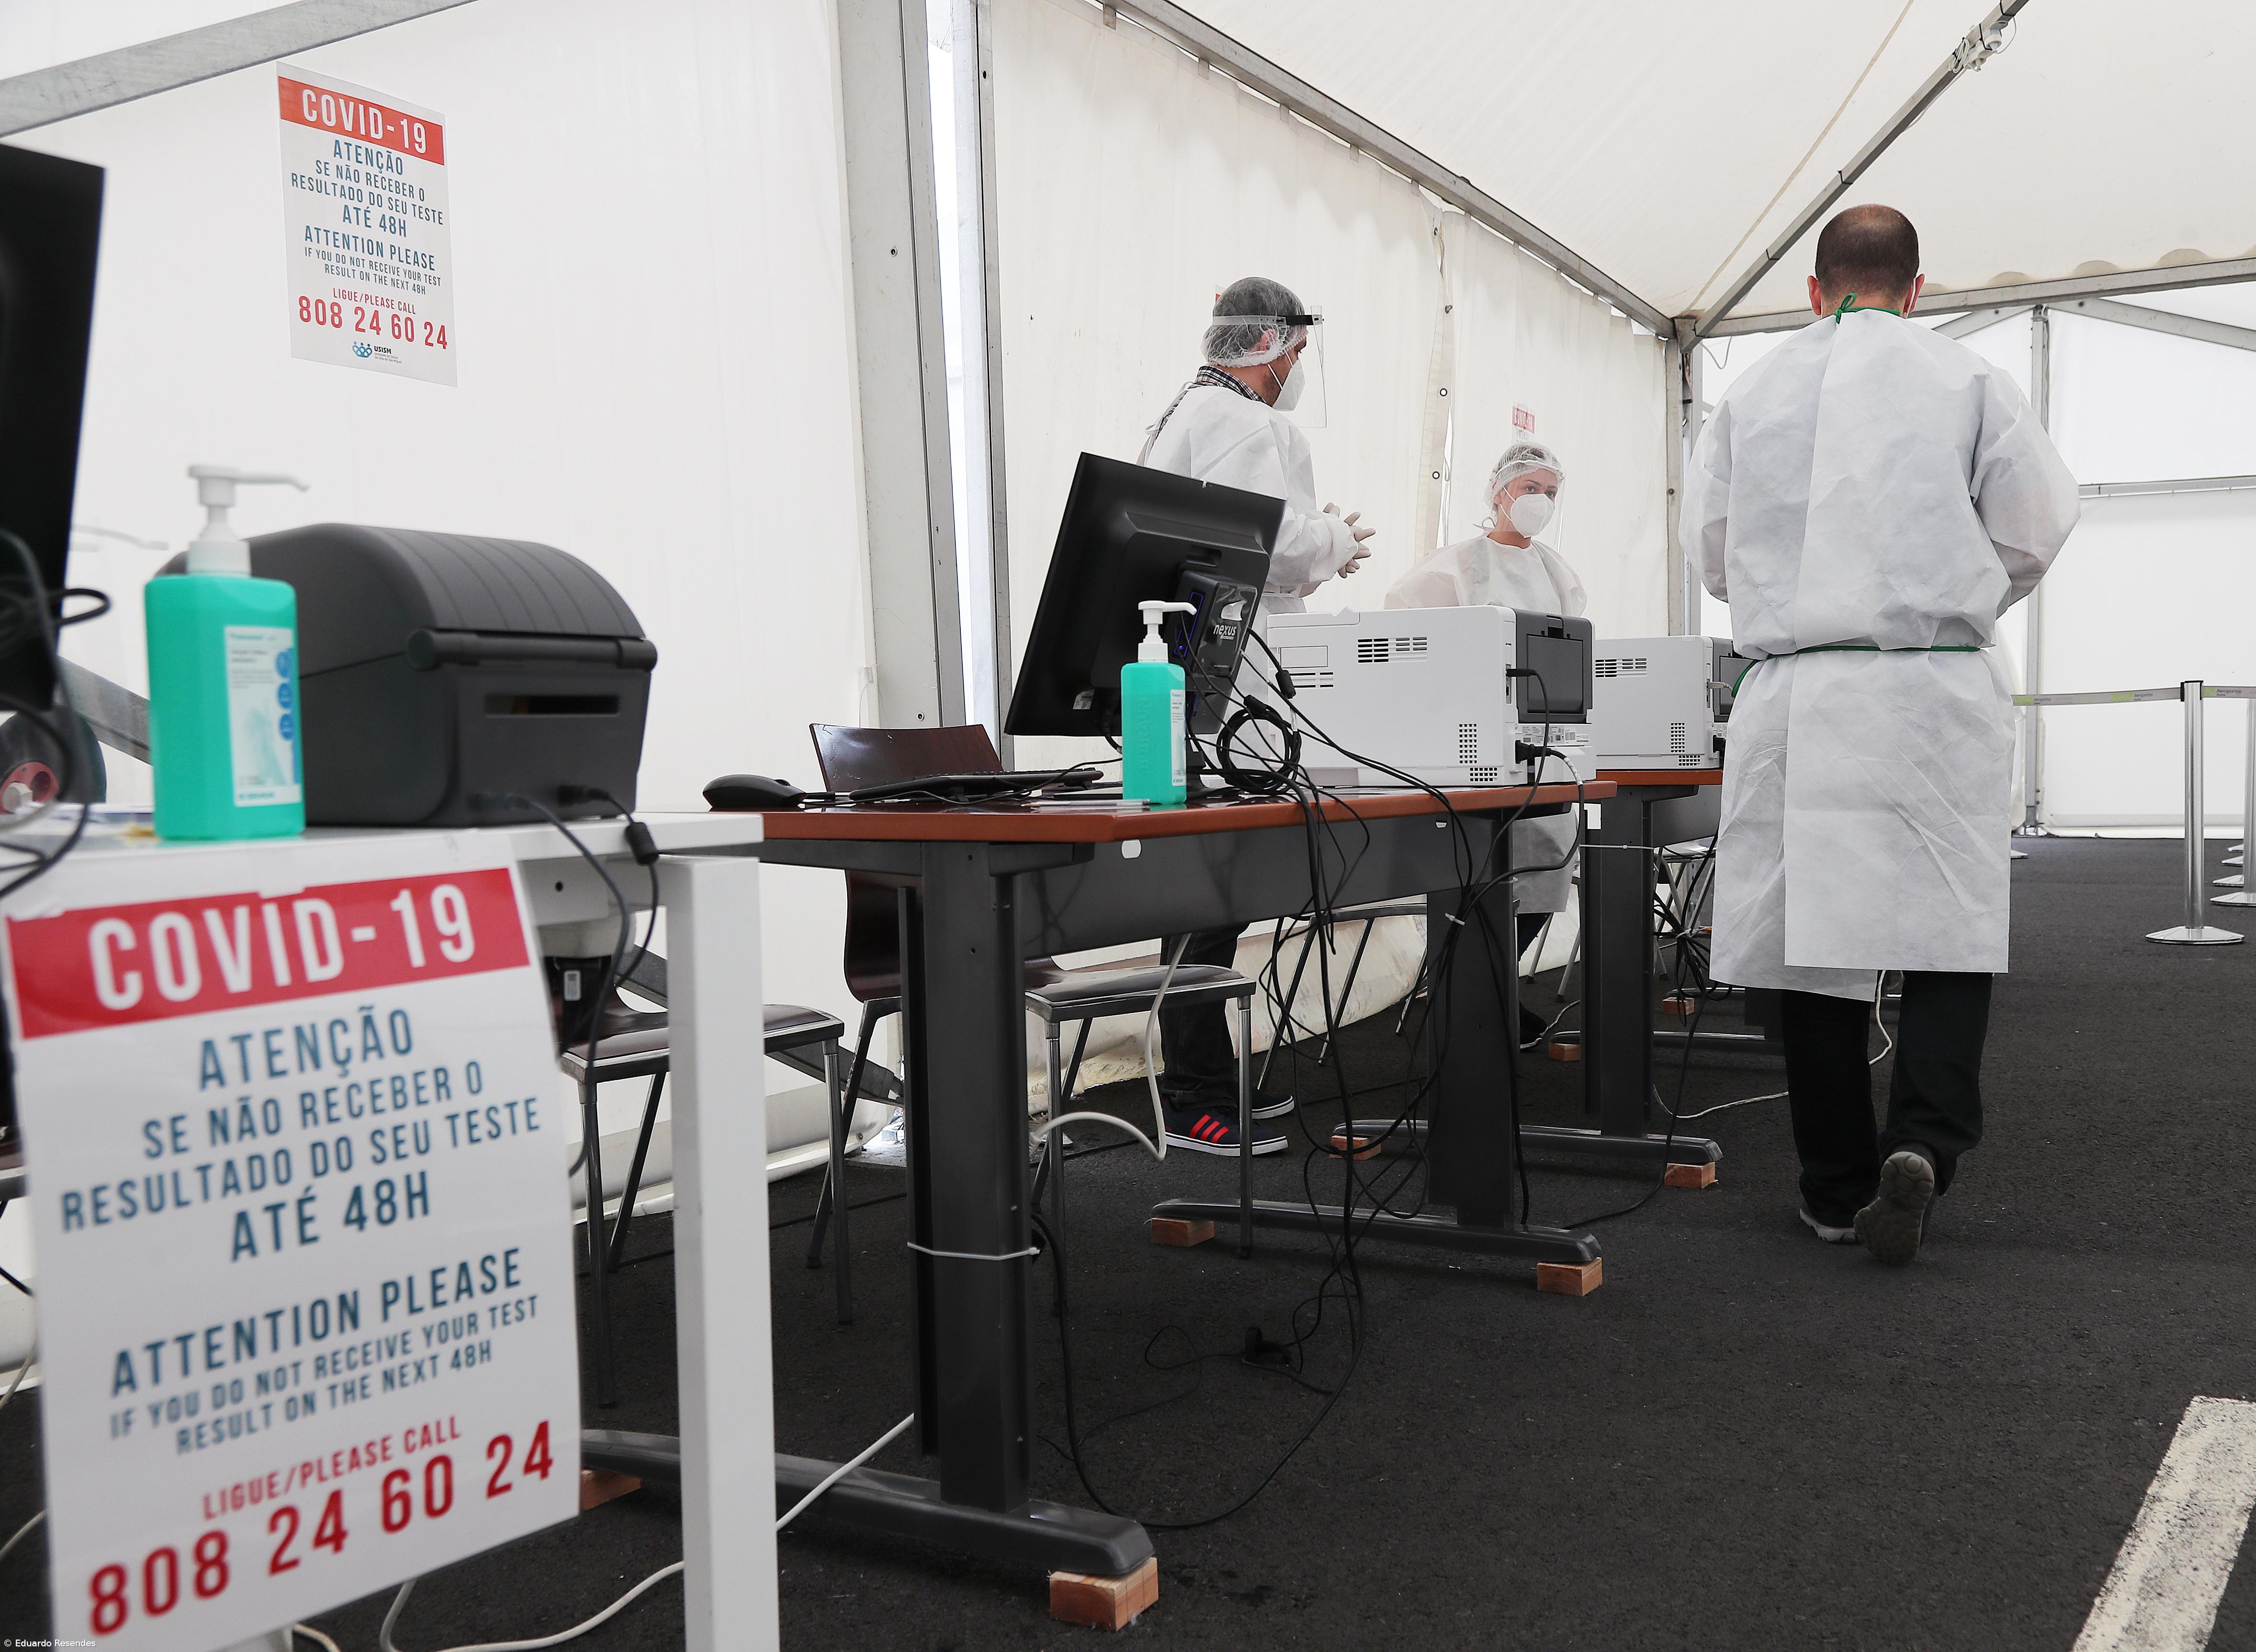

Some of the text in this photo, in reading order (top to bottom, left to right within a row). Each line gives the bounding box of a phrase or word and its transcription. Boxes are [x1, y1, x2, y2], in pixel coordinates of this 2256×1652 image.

[302, 89, 426, 154] COVID-19
[316, 160, 425, 202] SE NÃO RECEBER O
[334, 139, 403, 175] ATENÇÃO
[291, 172, 443, 225] RESULTADO DO SEU TESTE
[343, 205, 406, 238] ATÉ 48H
[305, 225, 435, 271] ATTENTION PLEASE
[305, 247, 441, 287] IF YOU DO NOT RECEIVE YOUR TEST
[325, 264, 426, 295] RESULT ON THE NEXT 48H
[333, 287, 416, 315] LIGUE/PLEASE CALL
[299, 296, 448, 350] 808 24 60 24
[374, 345, 392, 354] USISM
[1213, 624, 1237, 639] nexus
[89, 884, 475, 1010] COVID-19
[199, 1005, 413, 1091] ATENÇÃO
[142, 1060, 483, 1159] SE NÃO RECEBER O
[60, 1097, 540, 1233] RESULTADO DO SEU TESTE
[231, 1170, 430, 1262] ATÉ 48H
[111, 1247, 521, 1398] ATTENTION PLEASE
[111, 1294, 537, 1438] IF YOU DO NOT RECEIVE YOUR TEST
[176, 1340, 492, 1454] RESULT ON THE NEXT 48H
[203, 1415, 460, 1521] LIGUE/PLEASE CALL
[87, 1419, 554, 1638] 808 24 60 24
